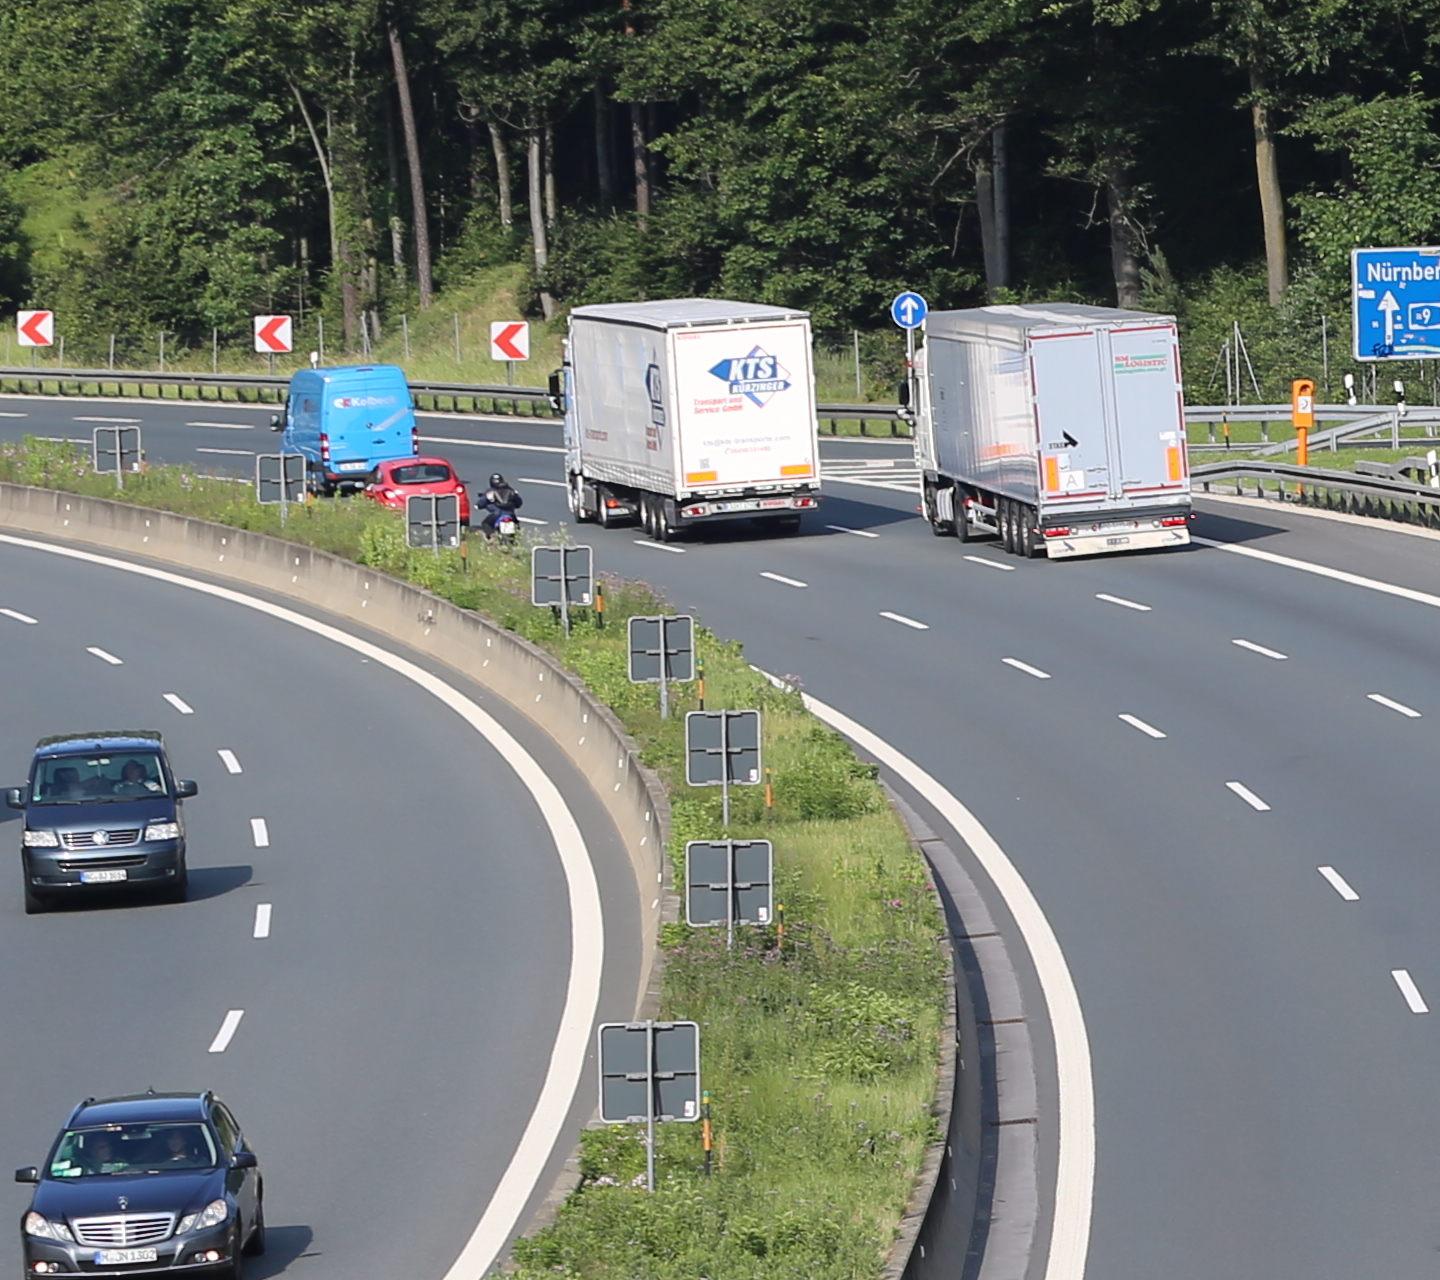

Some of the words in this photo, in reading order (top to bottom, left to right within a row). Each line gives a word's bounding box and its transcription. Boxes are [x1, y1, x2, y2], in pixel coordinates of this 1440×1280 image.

[1422, 308, 1431, 324] 9
[729, 356, 775, 381] KTS
[1125, 359, 1168, 368] LOGISTIC
